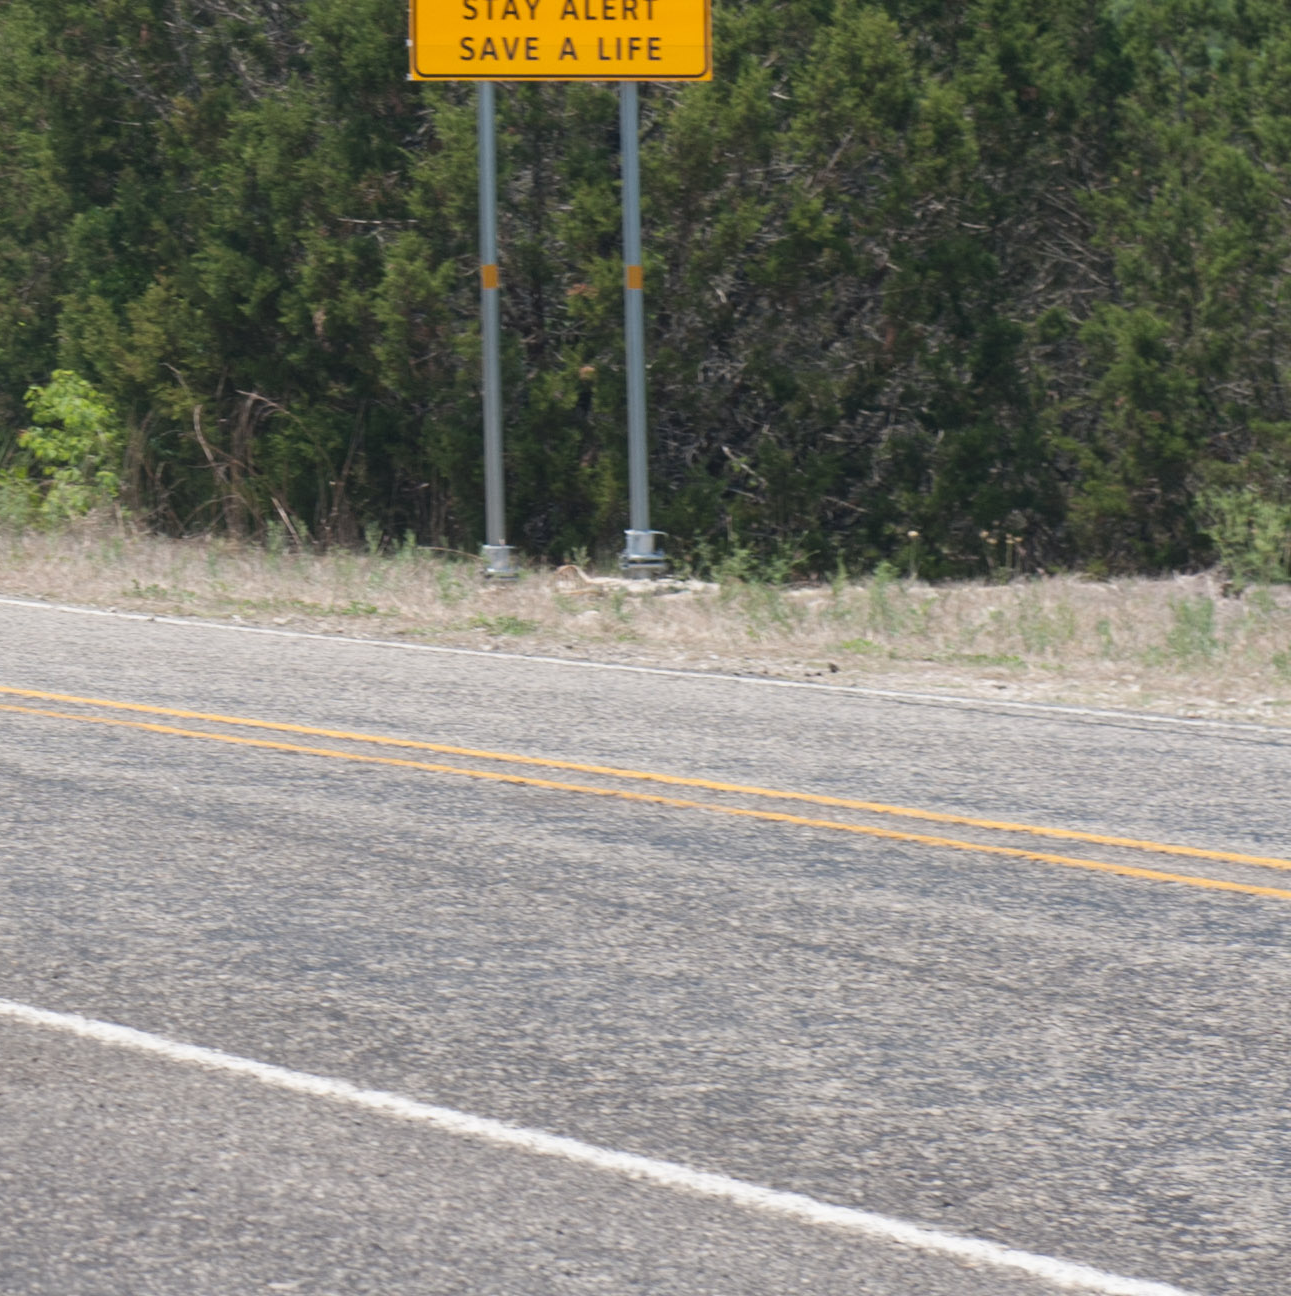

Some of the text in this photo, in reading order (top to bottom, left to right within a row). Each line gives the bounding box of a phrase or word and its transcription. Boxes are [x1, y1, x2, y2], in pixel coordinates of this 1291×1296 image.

[459, 37, 662, 61] SAVE A LIFE
